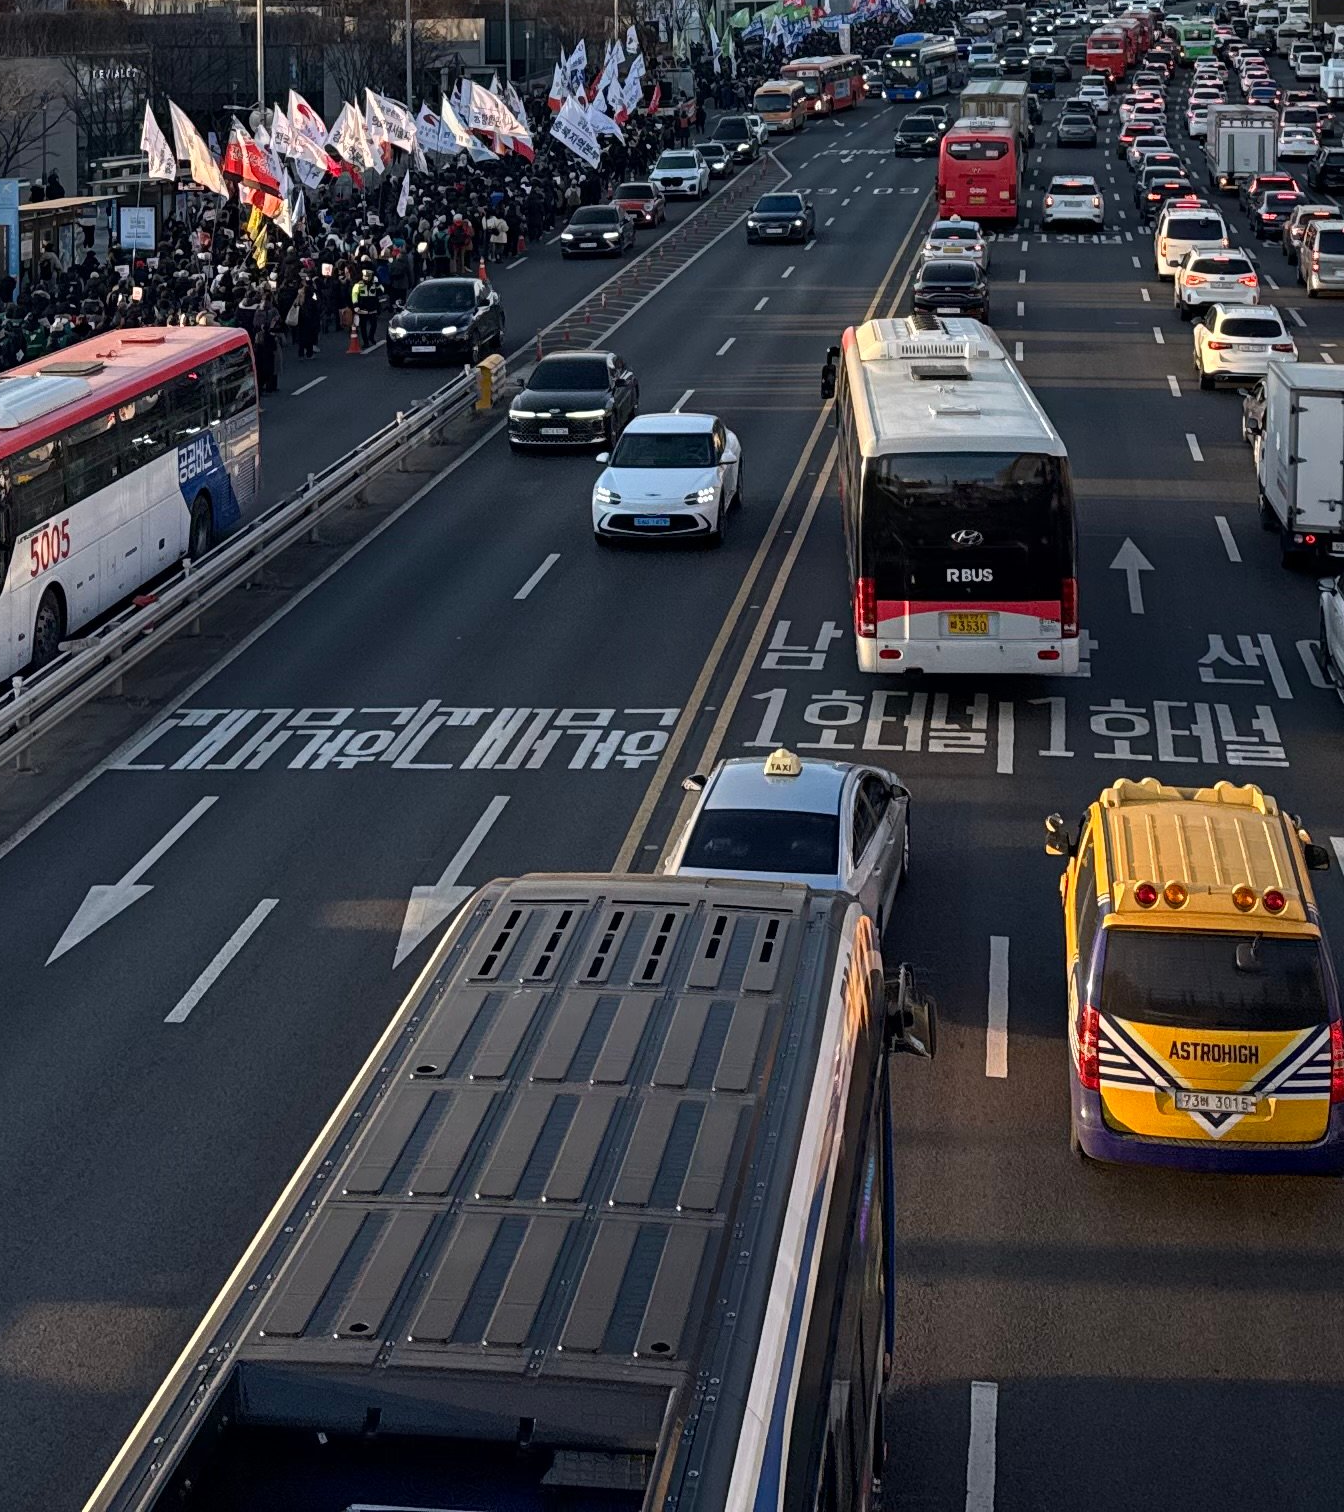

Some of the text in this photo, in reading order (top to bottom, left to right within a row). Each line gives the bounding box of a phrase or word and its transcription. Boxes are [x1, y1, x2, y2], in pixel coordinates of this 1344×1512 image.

[553, 121, 599, 160] 충북지역본부
[179, 435, 213, 483] 공공버스
[30, 518, 71, 577] 5005
[743, 688, 990, 753] 1호터널
[1028, 696, 1289, 768] 1호터널
[771, 763, 792, 772] TAXI
[1168, 1040, 1259, 1065] ASTROHIGH
[1215, 1096, 1248, 1110] 3015
